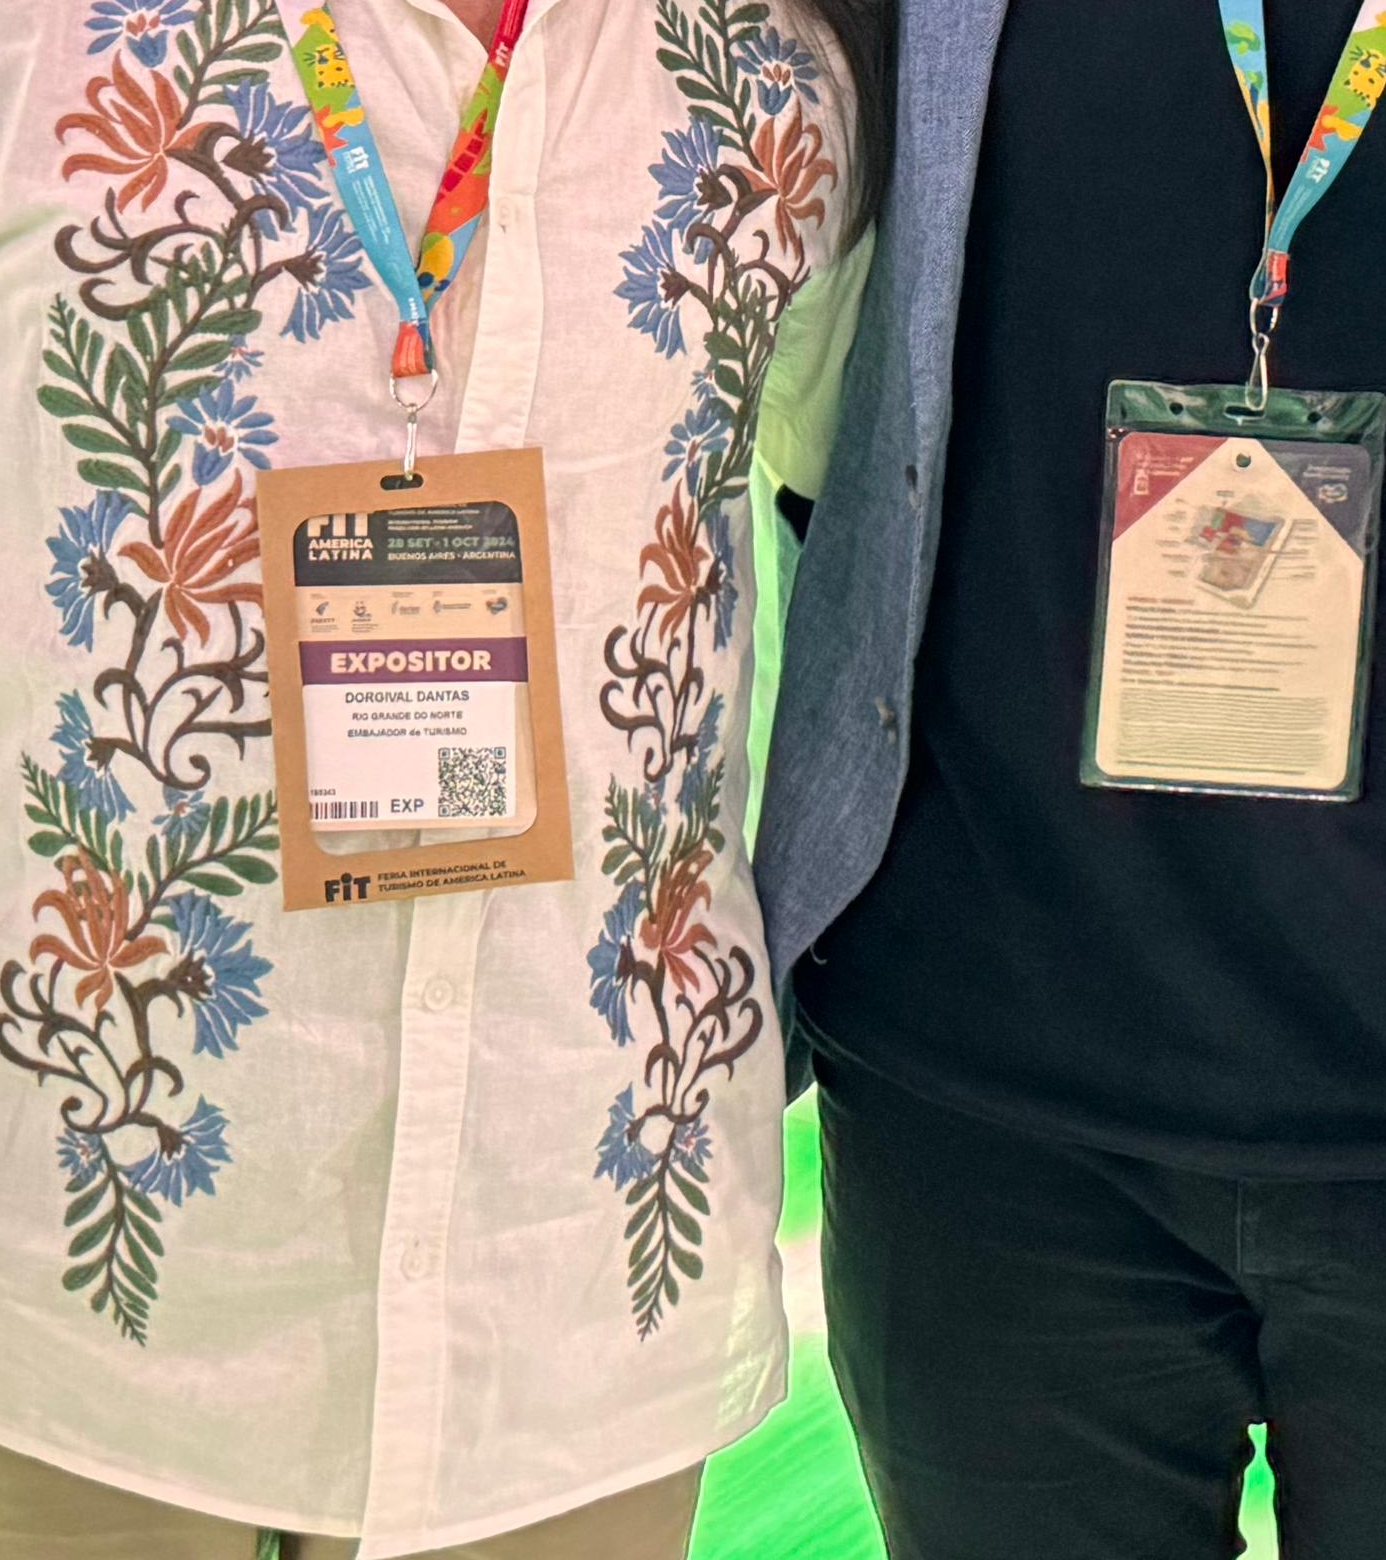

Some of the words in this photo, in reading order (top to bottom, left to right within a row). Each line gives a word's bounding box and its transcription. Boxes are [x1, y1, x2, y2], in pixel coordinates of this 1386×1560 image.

[308, 538, 374, 549] AMERICA
[407, 537, 431, 549] SET
[452, 536, 479, 547] OCT
[309, 549, 373, 561] LATINA
[387, 551, 427, 561] BUENOS
[428, 551, 455, 560] AIRES
[462, 550, 516, 560] ARGENTINA
[330, 649, 492, 674] EXPOSITOR
[345, 691, 413, 704] DORGIVAL
[416, 690, 470, 703] DANTAS
[371, 711, 411, 721] GRANDE
[414, 711, 428, 720] DO
[430, 710, 463, 720] NORTE
[347, 728, 407, 738] EMBAJADOR
[409, 728, 421, 737] de
[423, 727, 468, 736] TURISMO
[390, 798, 425, 813] EXP
[377, 871, 407, 881] FERIA
[409, 863, 491, 879] INTERNACIONAL
[493, 860, 507, 870] DE
[378, 881, 424, 893] TURISMO
[426, 878, 440, 888] DE
[490, 869, 526, 881] LATINA
